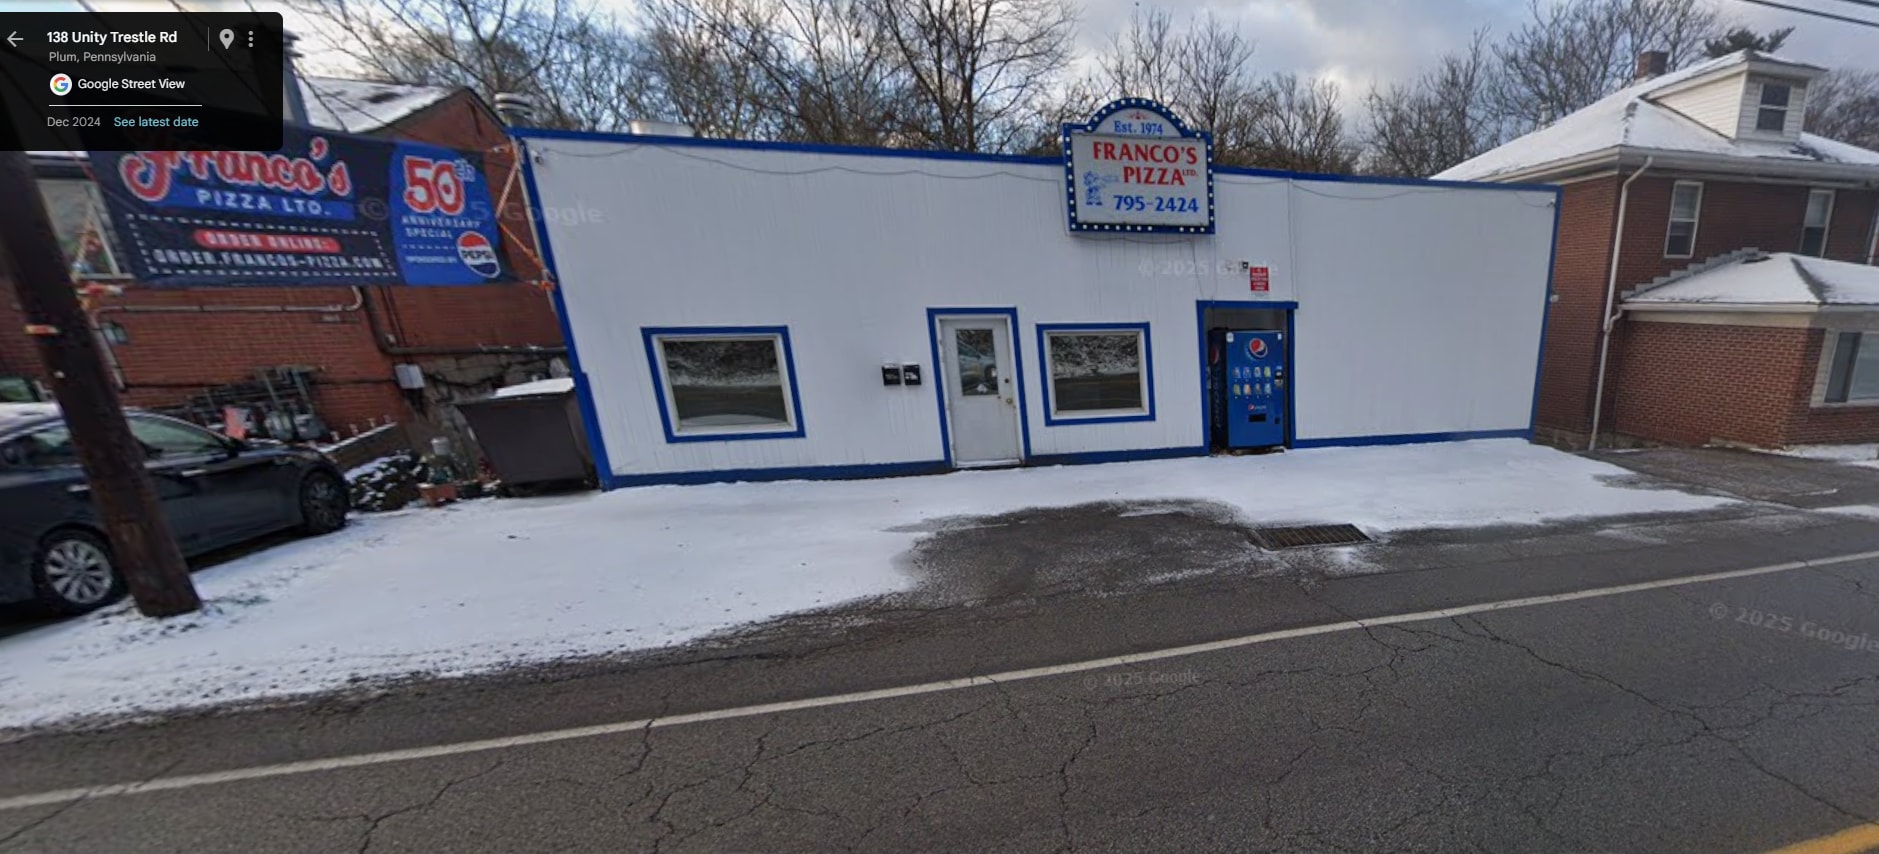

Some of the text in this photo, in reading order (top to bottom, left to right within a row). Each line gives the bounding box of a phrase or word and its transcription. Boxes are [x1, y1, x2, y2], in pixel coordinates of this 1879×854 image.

[1113, 119, 1164, 136] Est. 1974
[1092, 141, 1199, 166] FRANCO'S
[118, 135, 351, 202] Franco's
[1123, 166, 1199, 187] PIZZA LTD.
[195, 188, 332, 216] PIZZA LTD.
[1112, 194, 1200, 214] 795-2424
[401, 215, 482, 229] ANNIVERSARY
[204, 231, 263, 248] ORDER
[405, 227, 453, 239] SPECIAL
